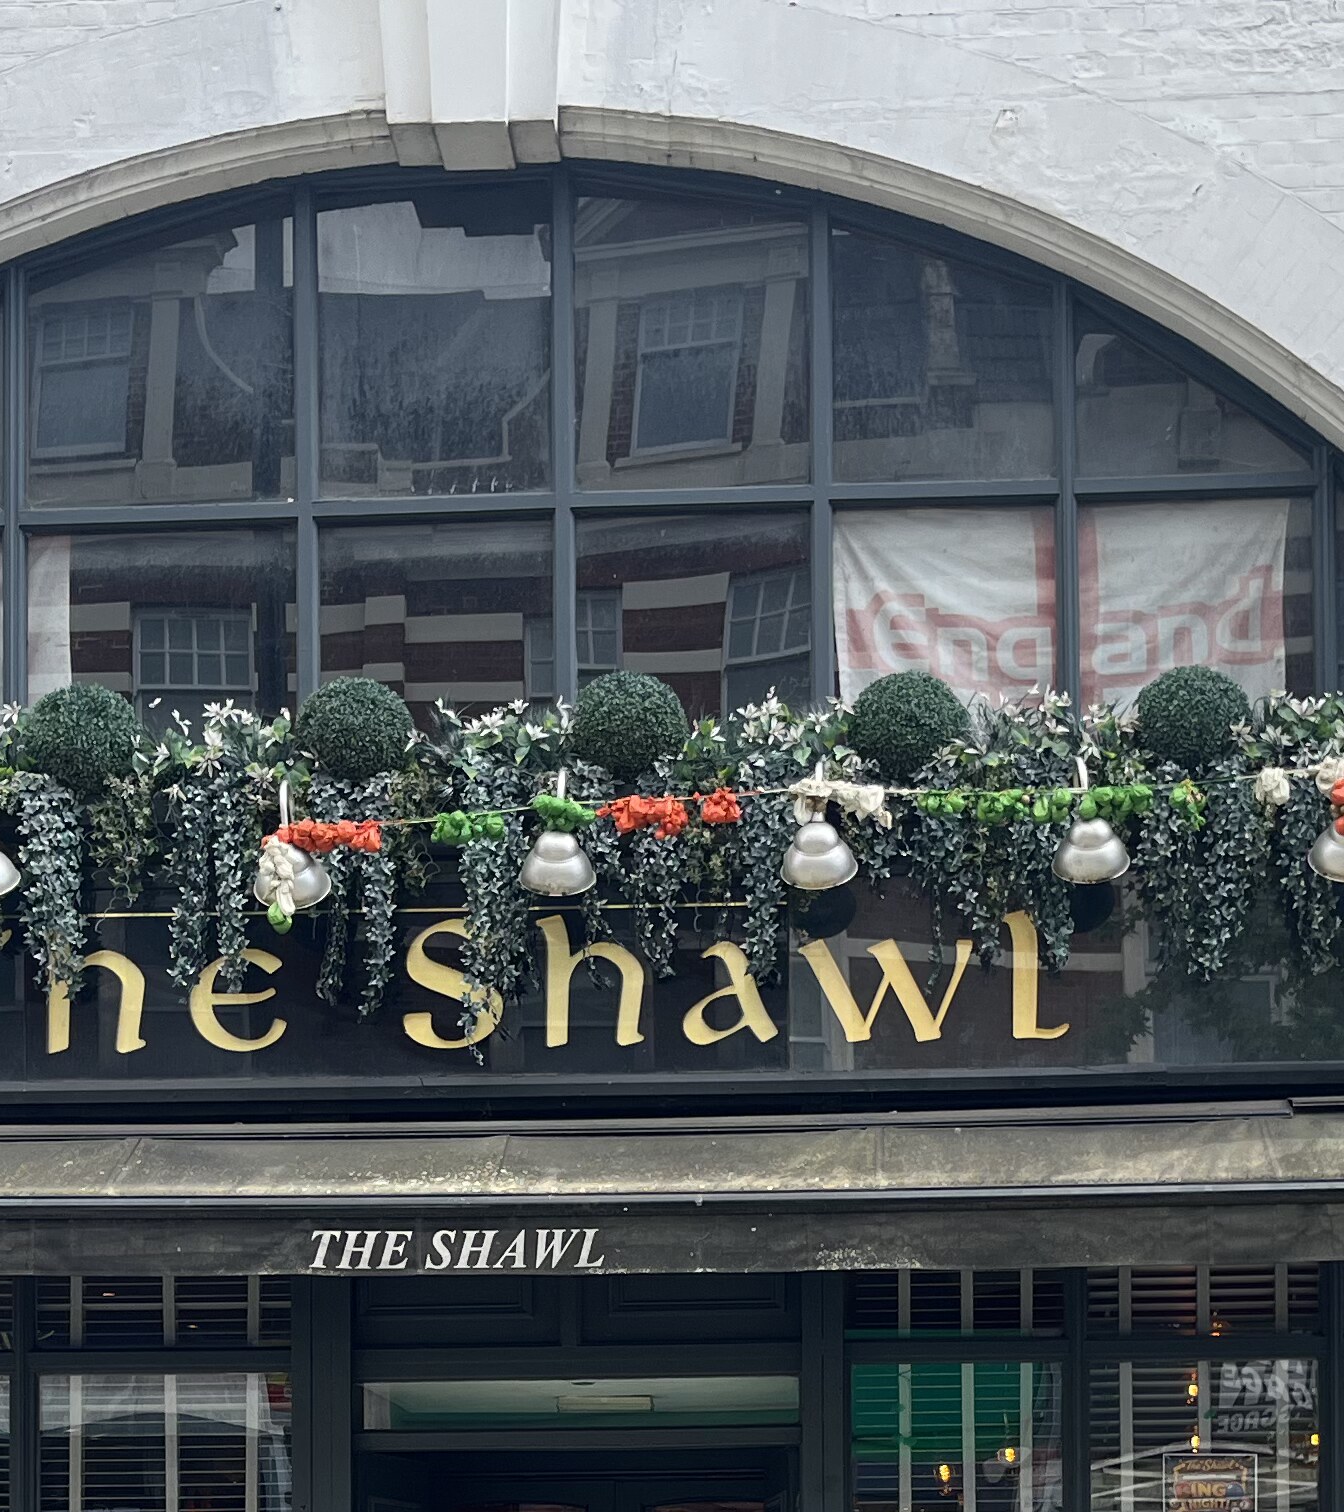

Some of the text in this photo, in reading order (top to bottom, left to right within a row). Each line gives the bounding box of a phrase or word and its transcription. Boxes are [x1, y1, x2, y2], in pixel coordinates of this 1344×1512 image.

[873, 577, 1265, 698] Engand
[402, 911, 1070, 1052] Shawl
[308, 1228, 605, 1270] THE SHAWL
